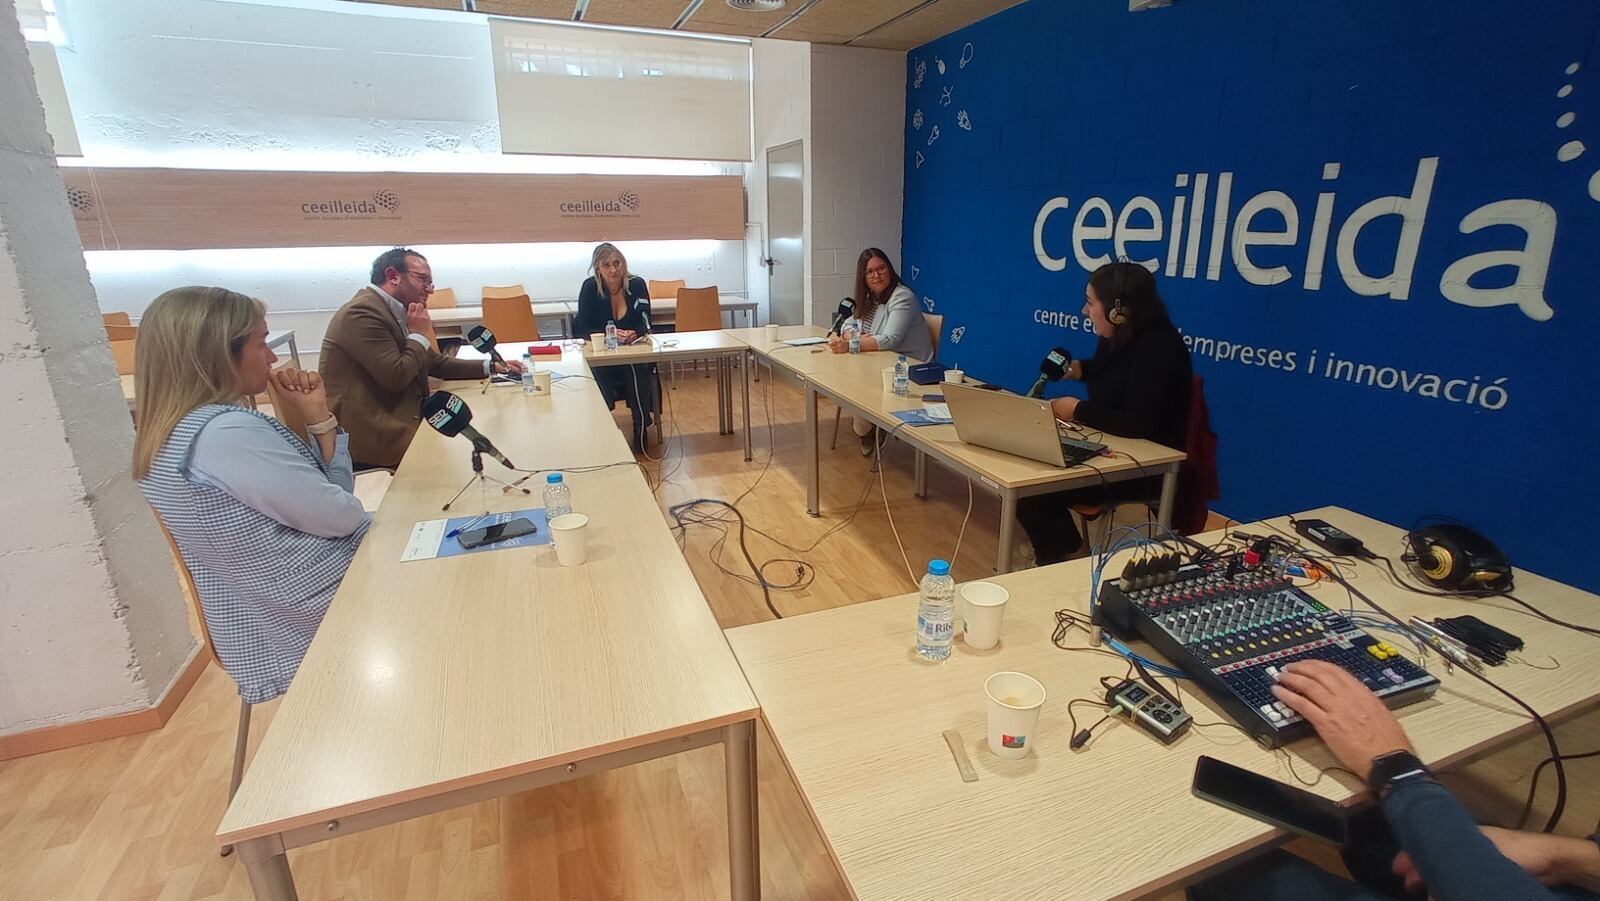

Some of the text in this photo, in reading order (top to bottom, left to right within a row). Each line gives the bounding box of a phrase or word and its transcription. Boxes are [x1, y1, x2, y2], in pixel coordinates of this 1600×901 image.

[301, 200, 376, 214] ceeilleida
[560, 200, 621, 213] ceeilleida
[1032, 156, 1557, 322] ceeilleida
[1033, 309, 1079, 330] centre
[1308, 349, 1318, 375] i
[1324, 352, 1509, 410] innovació
[428, 408, 450, 426] SER
